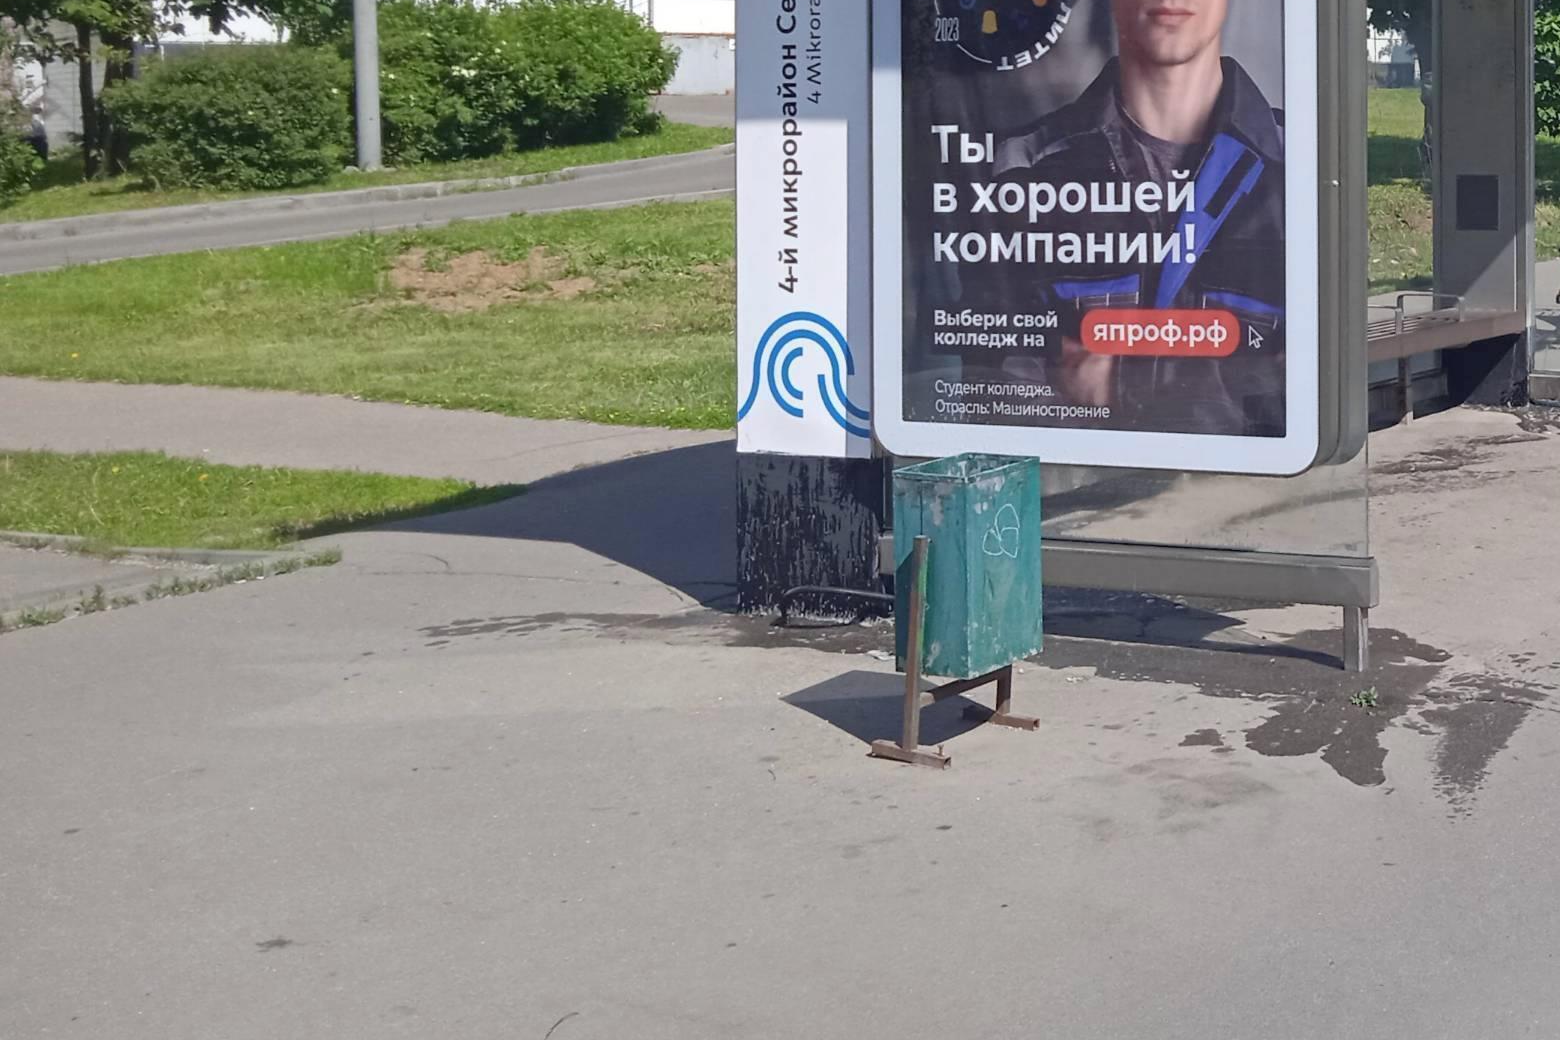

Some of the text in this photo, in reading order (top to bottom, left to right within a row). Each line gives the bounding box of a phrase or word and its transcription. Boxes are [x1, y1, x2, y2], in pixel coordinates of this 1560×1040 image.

[934, 17, 960, 42] 2023
[807, 90, 822, 104] 4
[777, 44, 803, 238] микрорайон
[931, 124, 994, 164] Ты
[933, 169, 1195, 223] в хорошей
[933, 223, 1197, 264] компании!
[778, 247, 799, 294] 4-й
[934, 309, 1059, 331] Выбери свой
[1093, 318, 1228, 348] япроф.рф
[934, 331, 1045, 348] колледж на
[934, 379, 1055, 399] Студент колледжа.
[934, 398, 1111, 420] Отрасль: Машиностроение
